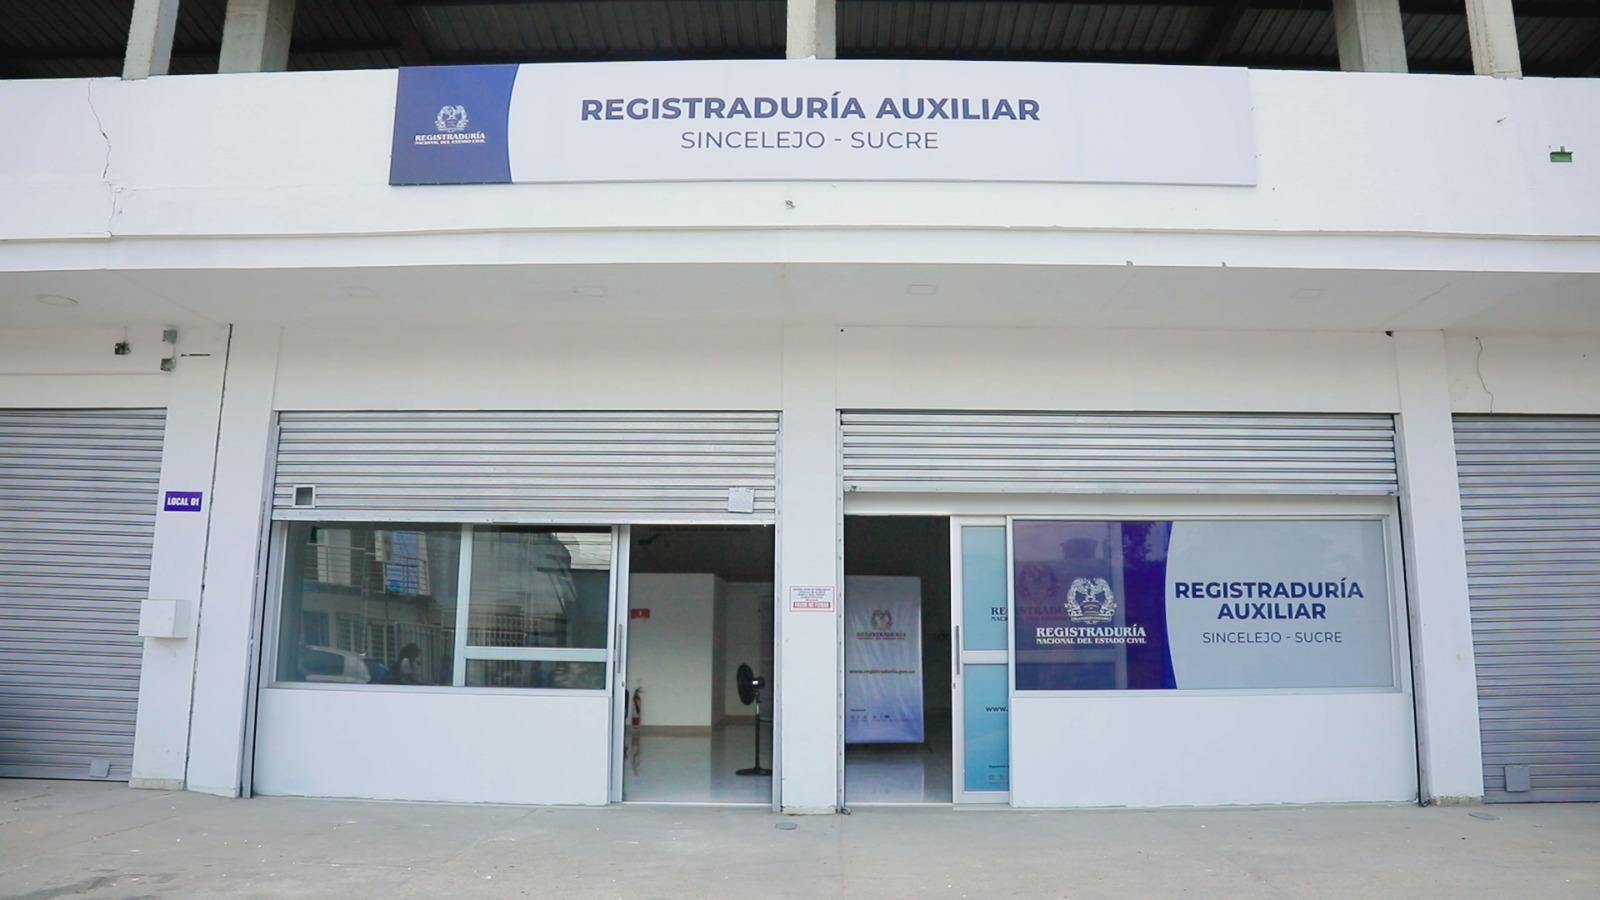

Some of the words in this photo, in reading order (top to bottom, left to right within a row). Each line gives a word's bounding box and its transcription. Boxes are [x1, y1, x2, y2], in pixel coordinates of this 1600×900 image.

[581, 91, 866, 121] REGISTRADURÍA
[875, 97, 1040, 121] AUXILIAR
[415, 131, 486, 141] REGISTRADURÍA
[681, 131, 825, 149] SINCELEJO
[850, 131, 939, 149] SUCRE
[167, 497, 189, 506] LOCAL
[190, 497, 200, 506] 01
[1175, 578, 1364, 599] REGISTRADURÍA
[1217, 603, 1327, 620] AUXILIAR
[1036, 624, 1147, 638] REGISTRADURÍA
[1202, 632, 1282, 644] SINCELEJO
[1295, 631, 1343, 643] SUCRE
[1036, 637, 1076, 645] NACIONAL
